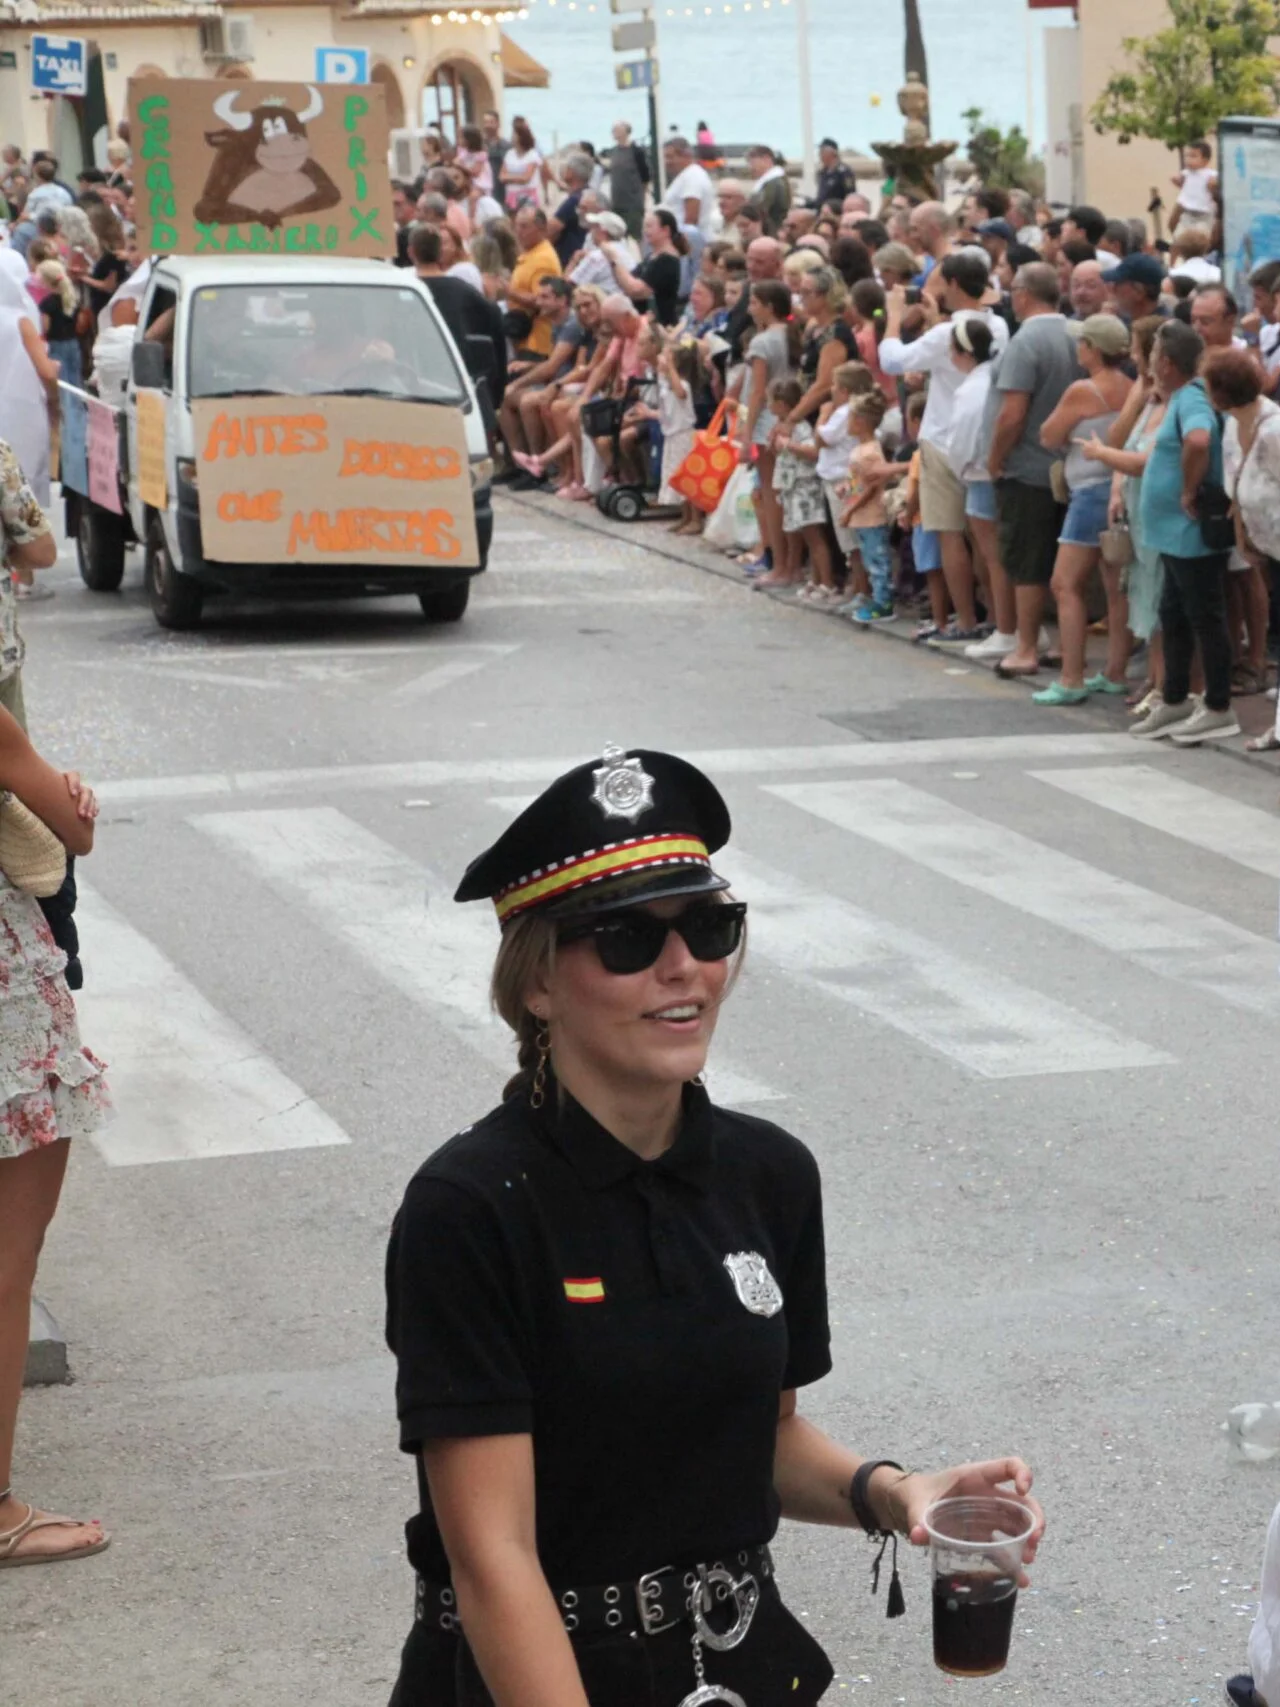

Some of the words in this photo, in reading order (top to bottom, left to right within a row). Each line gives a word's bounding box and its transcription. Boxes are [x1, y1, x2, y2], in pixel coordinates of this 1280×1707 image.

[35, 54, 80, 72] TAXI
[343, 95, 385, 242] PRIX
[203, 411, 328, 462] ANTES
[216, 489, 283, 522] QUE
